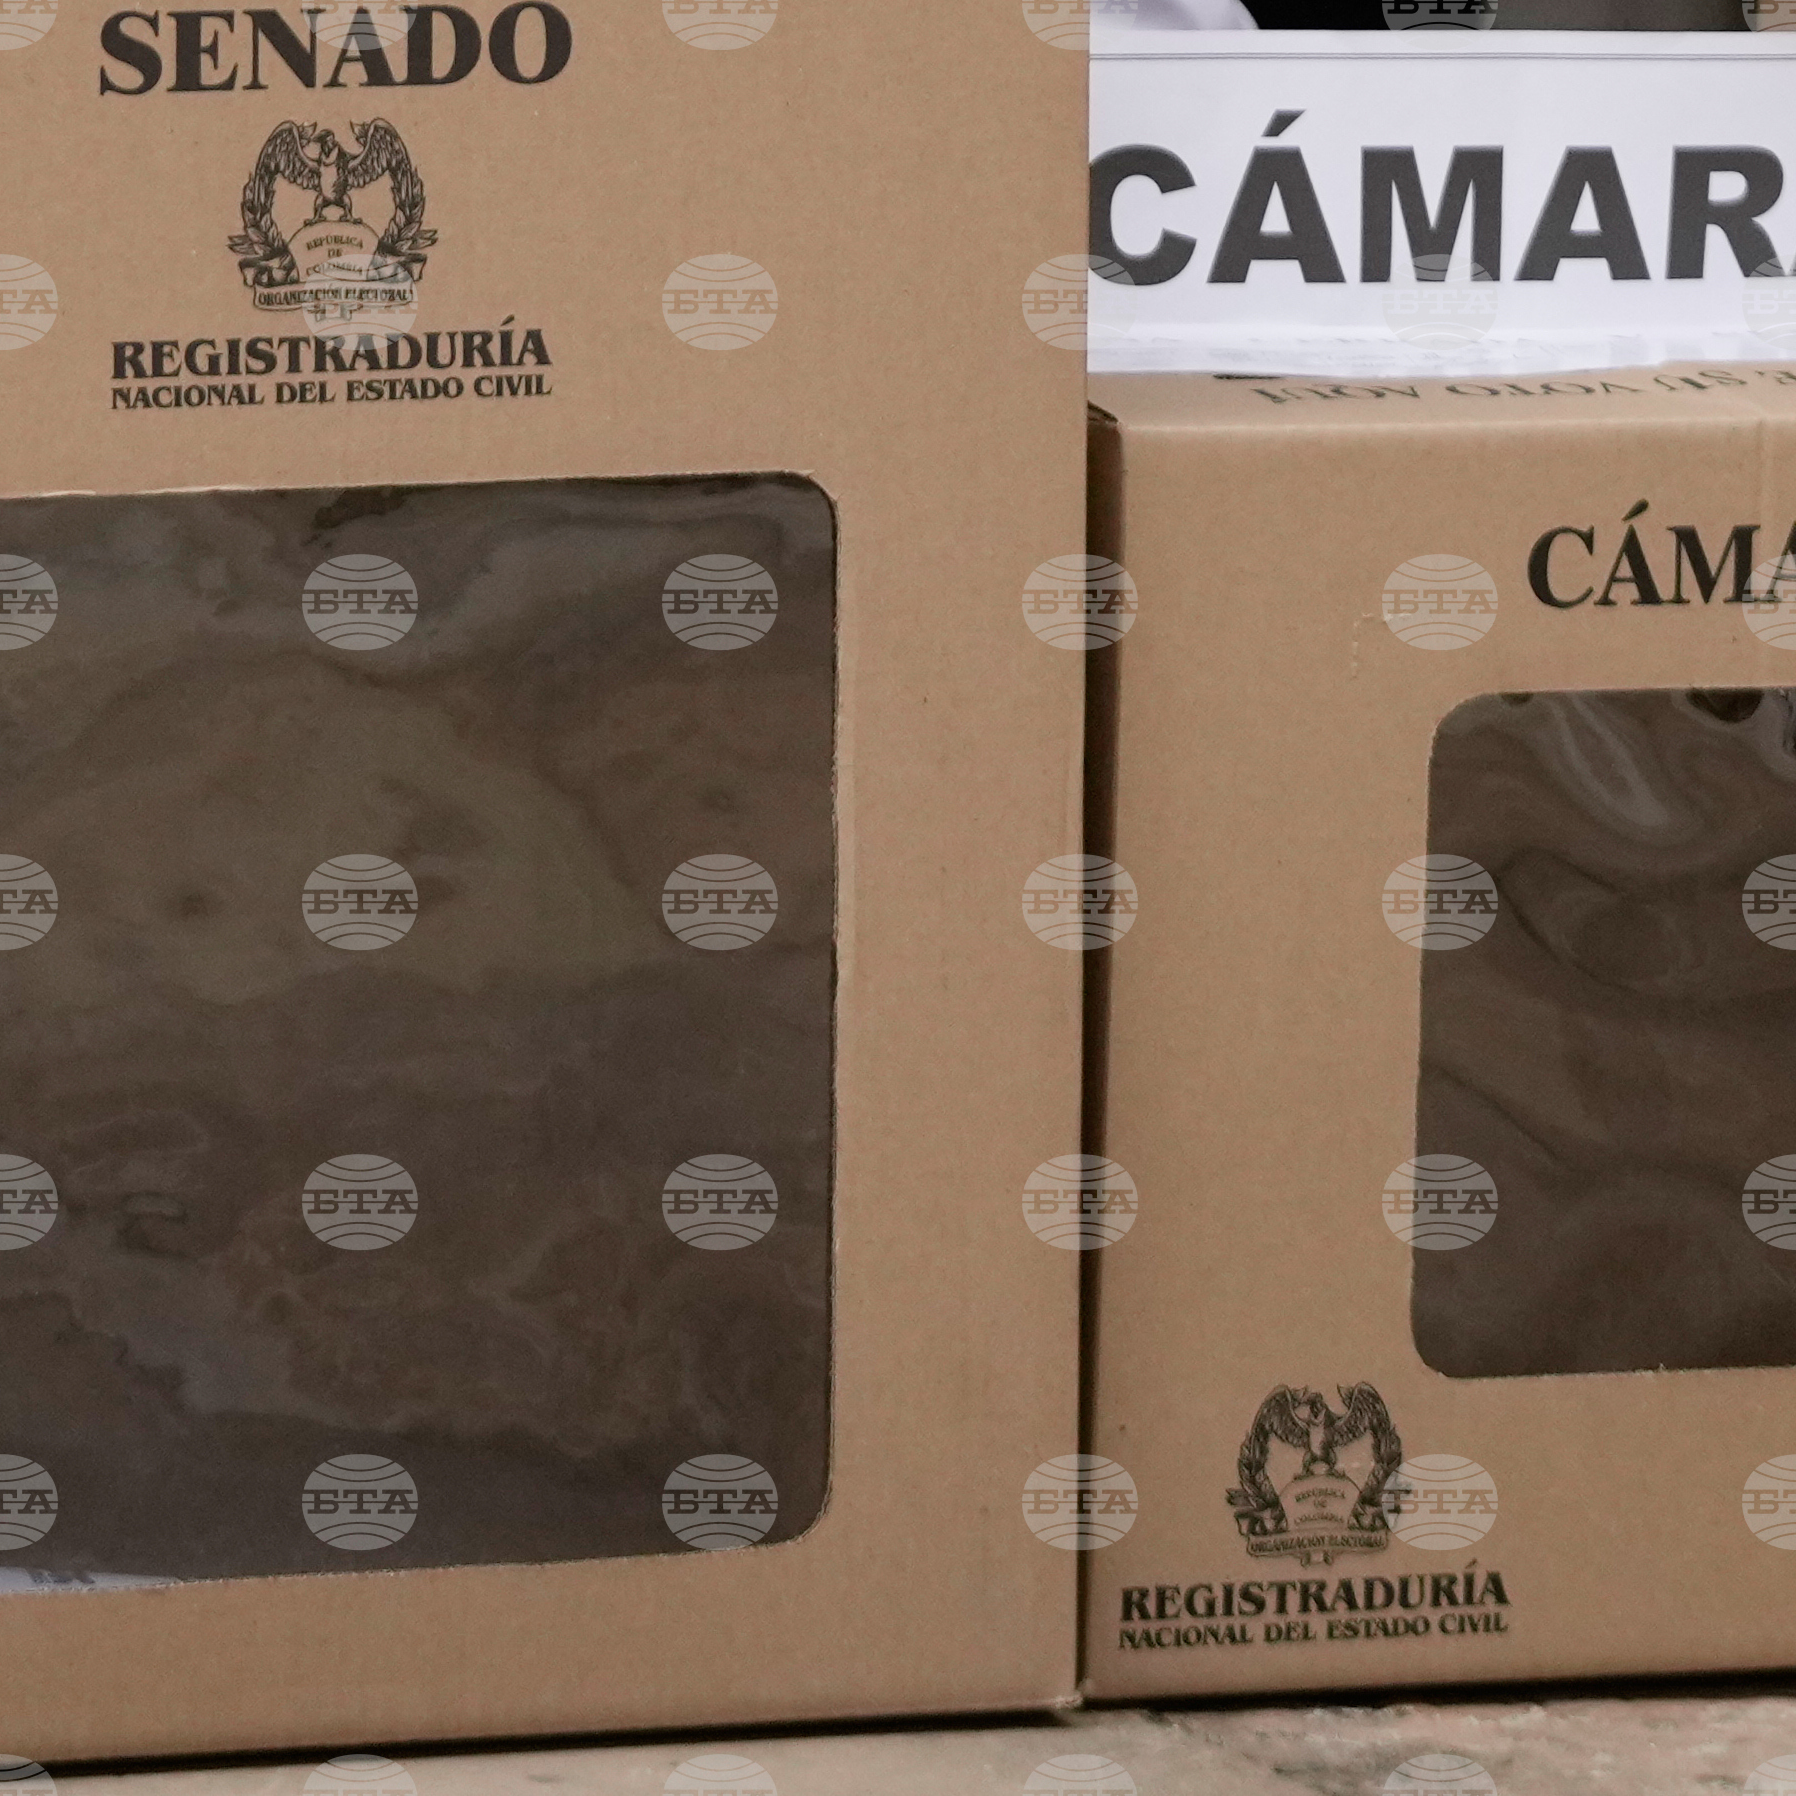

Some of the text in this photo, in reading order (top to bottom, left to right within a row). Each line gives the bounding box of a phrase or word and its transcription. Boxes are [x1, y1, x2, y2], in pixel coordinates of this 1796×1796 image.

[99, 0, 573, 95] SENADO
[1088, 108, 1796, 287] CÁMAR
[111, 315, 552, 379] REGISTRADURÍA
[111, 373, 553, 409] NACIONAL DEL ESTADO CIVIL
[1445, 380, 1639, 398] VOTO
[1120, 1558, 1513, 1621] REGISTRADURÍA
[1118, 1611, 1509, 1650] NACIONAL DEL ESTADO CIVIL
